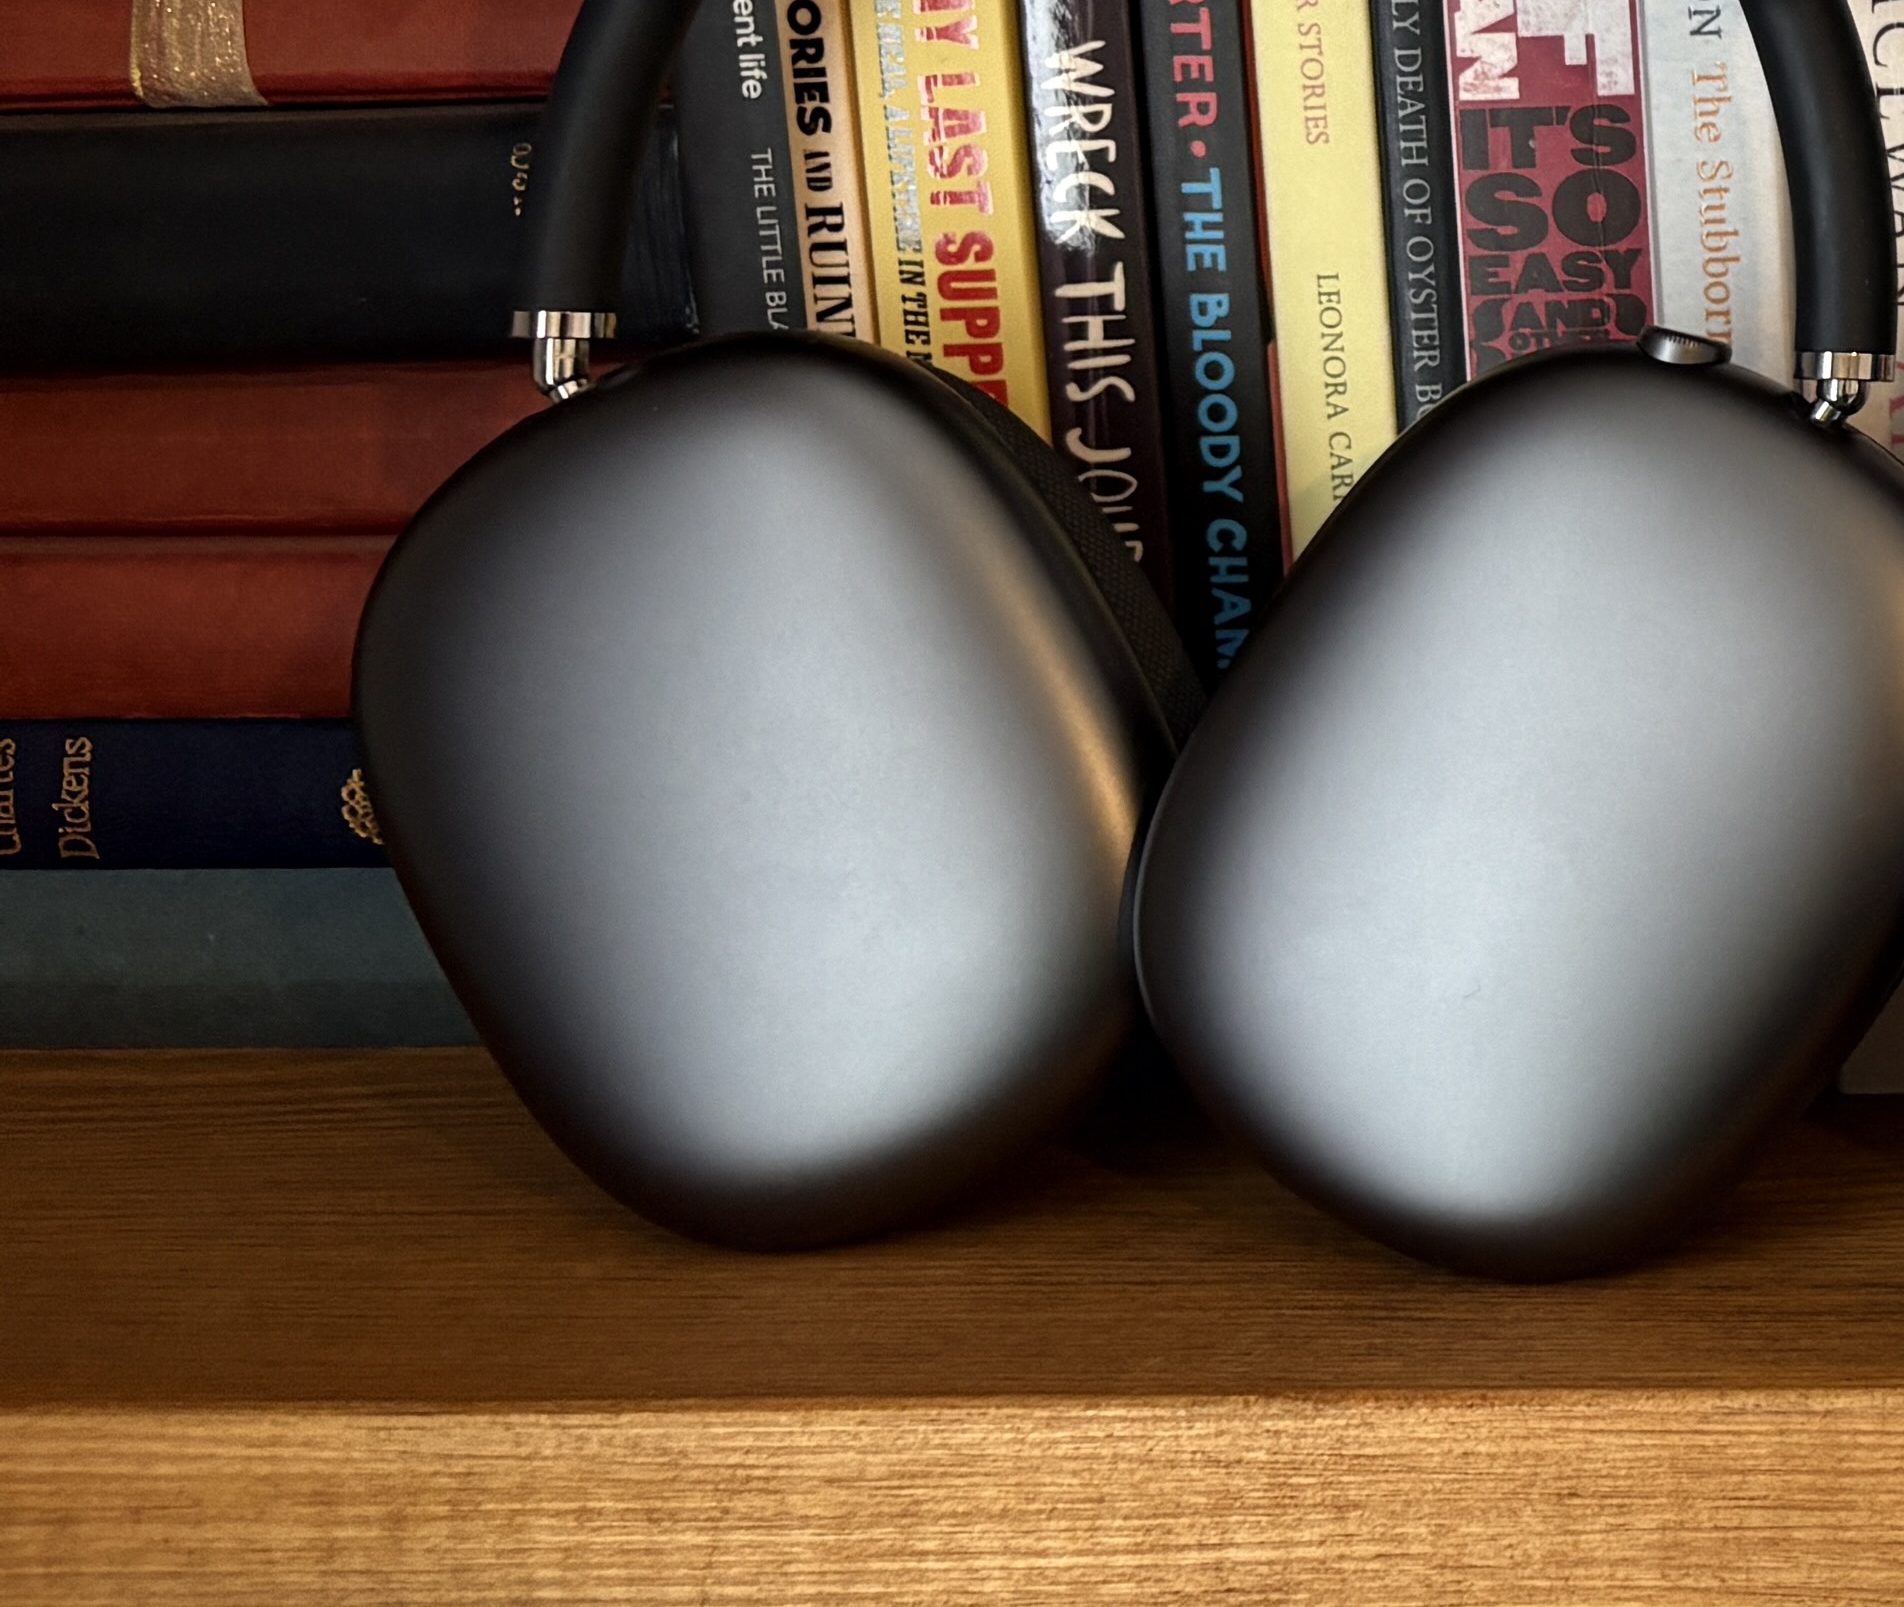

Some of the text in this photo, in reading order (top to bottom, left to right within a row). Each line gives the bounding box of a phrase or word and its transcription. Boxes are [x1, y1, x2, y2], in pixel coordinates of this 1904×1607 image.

[737, 53, 768, 101] life
[1297, 23, 1330, 146] STORIES
[1393, 49, 1430, 168] DEATH
[1690, 61, 1732, 143] The
[751, 147, 777, 200] THE
[803, 149, 834, 193] AND
[917, 71, 994, 216] LAST
[1039, 39, 1127, 247] WRECK
[1459, 104, 1637, 171] IT'S
[757, 205, 788, 284] LITTLE
[1181, 167, 1228, 272] THE
[1402, 178, 1433, 225] OF
[1464, 167, 1642, 252] SO
[804, 202, 858, 339] RUIN
[898, 258, 927, 287] IN
[902, 292, 932, 354] THE
[935, 230, 1009, 408] SUPP
[1405, 235, 1442, 372] OYSTER
[1468, 248, 1643, 296] EASY
[1054, 261, 1137, 404] THIS
[1316, 272, 1350, 421] LEONORA
[1189, 292, 1245, 504] BLOODY
[53, 736, 100, 859] Dickens
